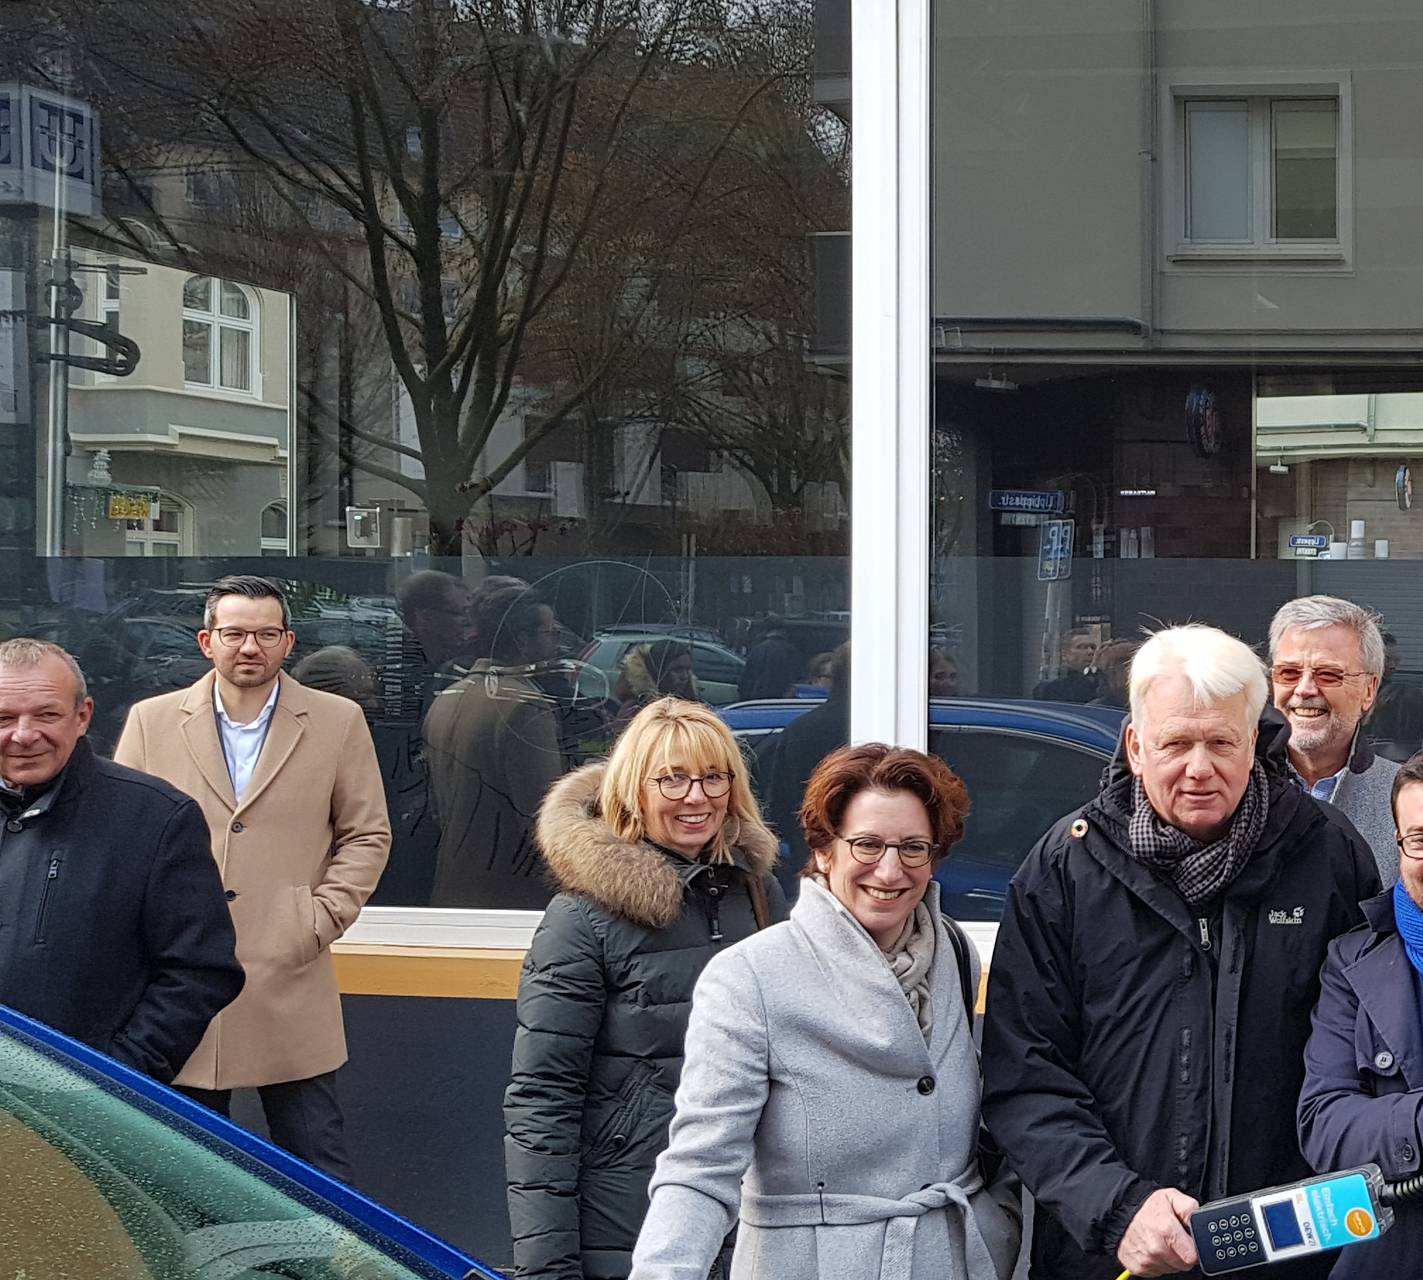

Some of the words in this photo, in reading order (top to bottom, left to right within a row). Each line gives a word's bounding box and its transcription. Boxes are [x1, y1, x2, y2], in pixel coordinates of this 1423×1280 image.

[1270, 909, 1287, 917] Jack
[1268, 914, 1302, 924] Wolfskin
[1321, 1186, 1338, 1226] Einfach
